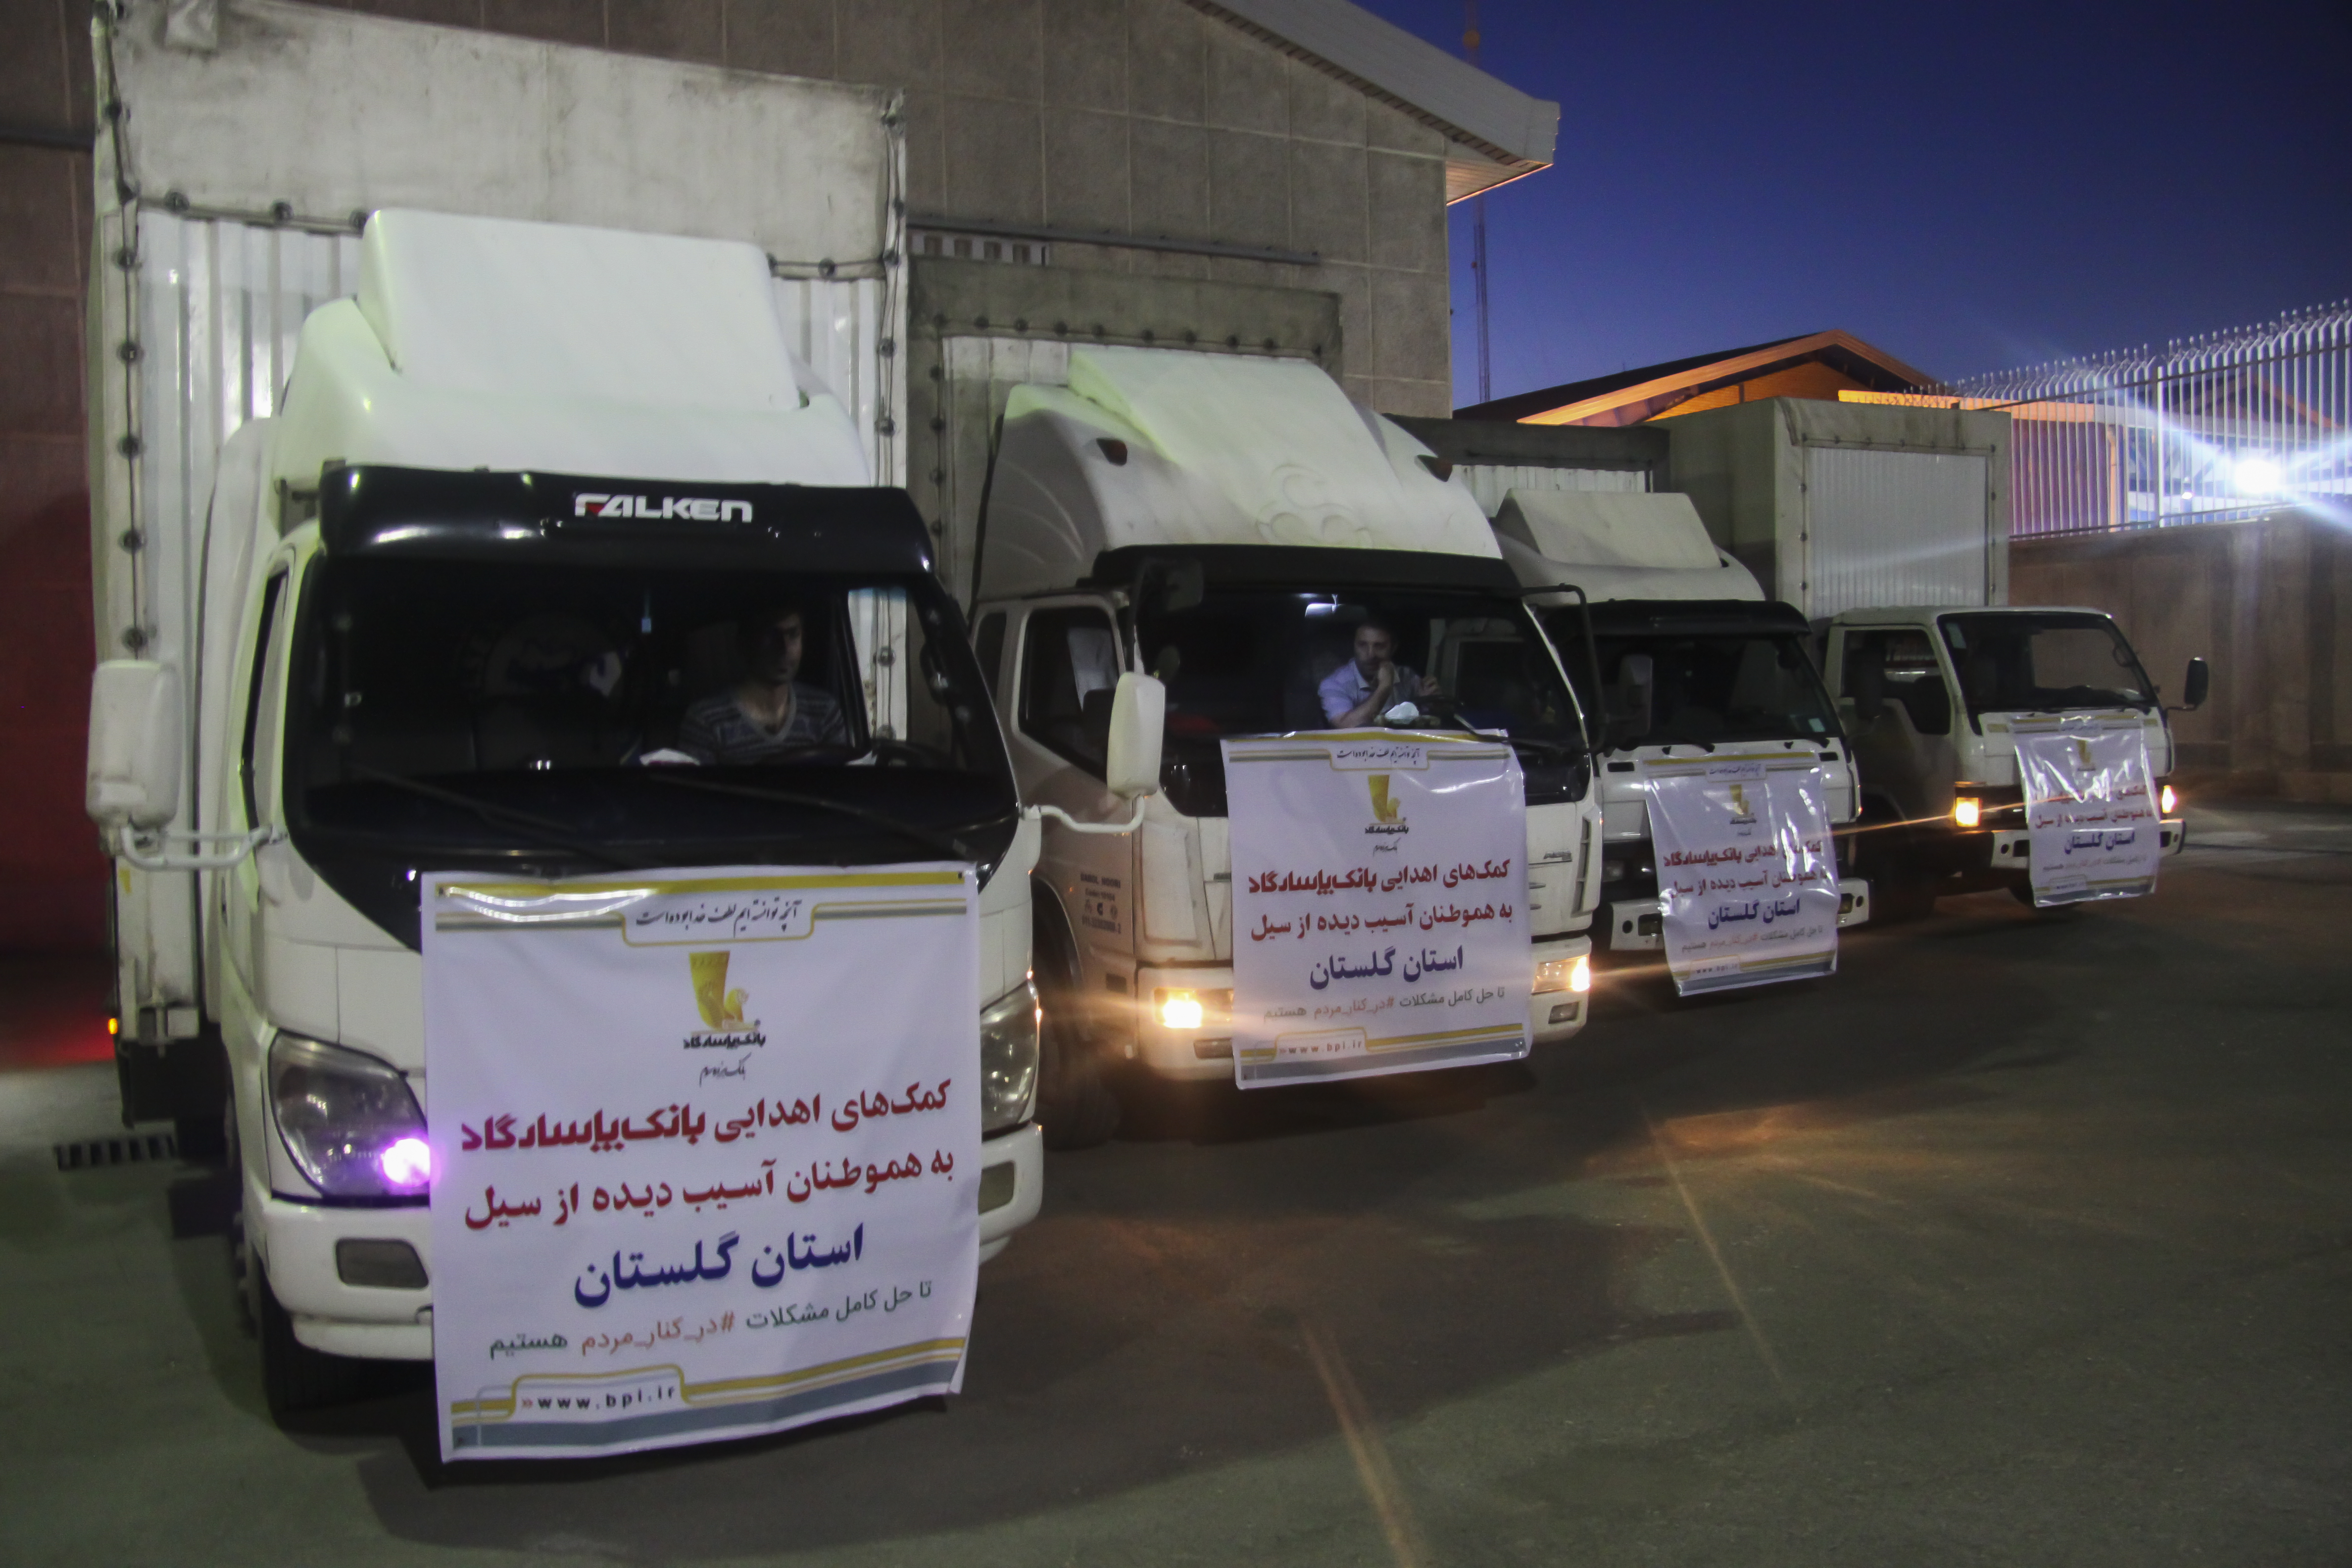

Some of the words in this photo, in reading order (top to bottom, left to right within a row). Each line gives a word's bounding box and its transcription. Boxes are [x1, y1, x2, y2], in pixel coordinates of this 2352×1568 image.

[575, 493, 753, 523] FALKEN
[2064, 833, 2104, 854] گلستان
[2105, 832, 2135, 850] استان
[1381, 864, 1437, 892] اهدایی
[1697, 878, 1707, 896] از
[1710, 879, 1736, 892] دیده
[1738, 870, 1769, 893] آسیب
[1317, 913, 1359, 936] دیده
[1364, 903, 1414, 936] آسیب
[1419, 904, 1494, 931] هموطنان
[1499, 903, 1513, 923] به
[1708, 899, 1760, 930] گلستان
[1763, 898, 1801, 924] استان
[1251, 914, 1291, 941] سیل
[1297, 913, 1311, 938] از
[1310, 946, 1396, 989] گلستان
[1403, 945, 1464, 982] استان
[1400, 993, 1444, 1008] مشکلات
[1448, 989, 1472, 1007] کامل
[1475, 989, 1493, 1004] حل
[1497, 986, 1505, 999] تا
[1264, 1007, 1307, 1022] هستیم
[714, 1094, 820, 1142] اهدایی
[786, 1153, 922, 1203] هموطنان
[930, 1149, 954, 1182] به
[592, 1180, 671, 1218] دیده
[683, 1161, 775, 1212] آسیب
[464, 1185, 541, 1230] سیل
[553, 1183, 579, 1226] از
[574, 1230, 740, 1307] گلستان
[750, 1223, 864, 1287] استان
[884, 1286, 913, 1312] حل
[919, 1280, 932, 1299] تا
[745, 1303, 829, 1332] مشکلات
[835, 1292, 877, 1323] کامل
[490, 1332, 568, 1358] هستیم
